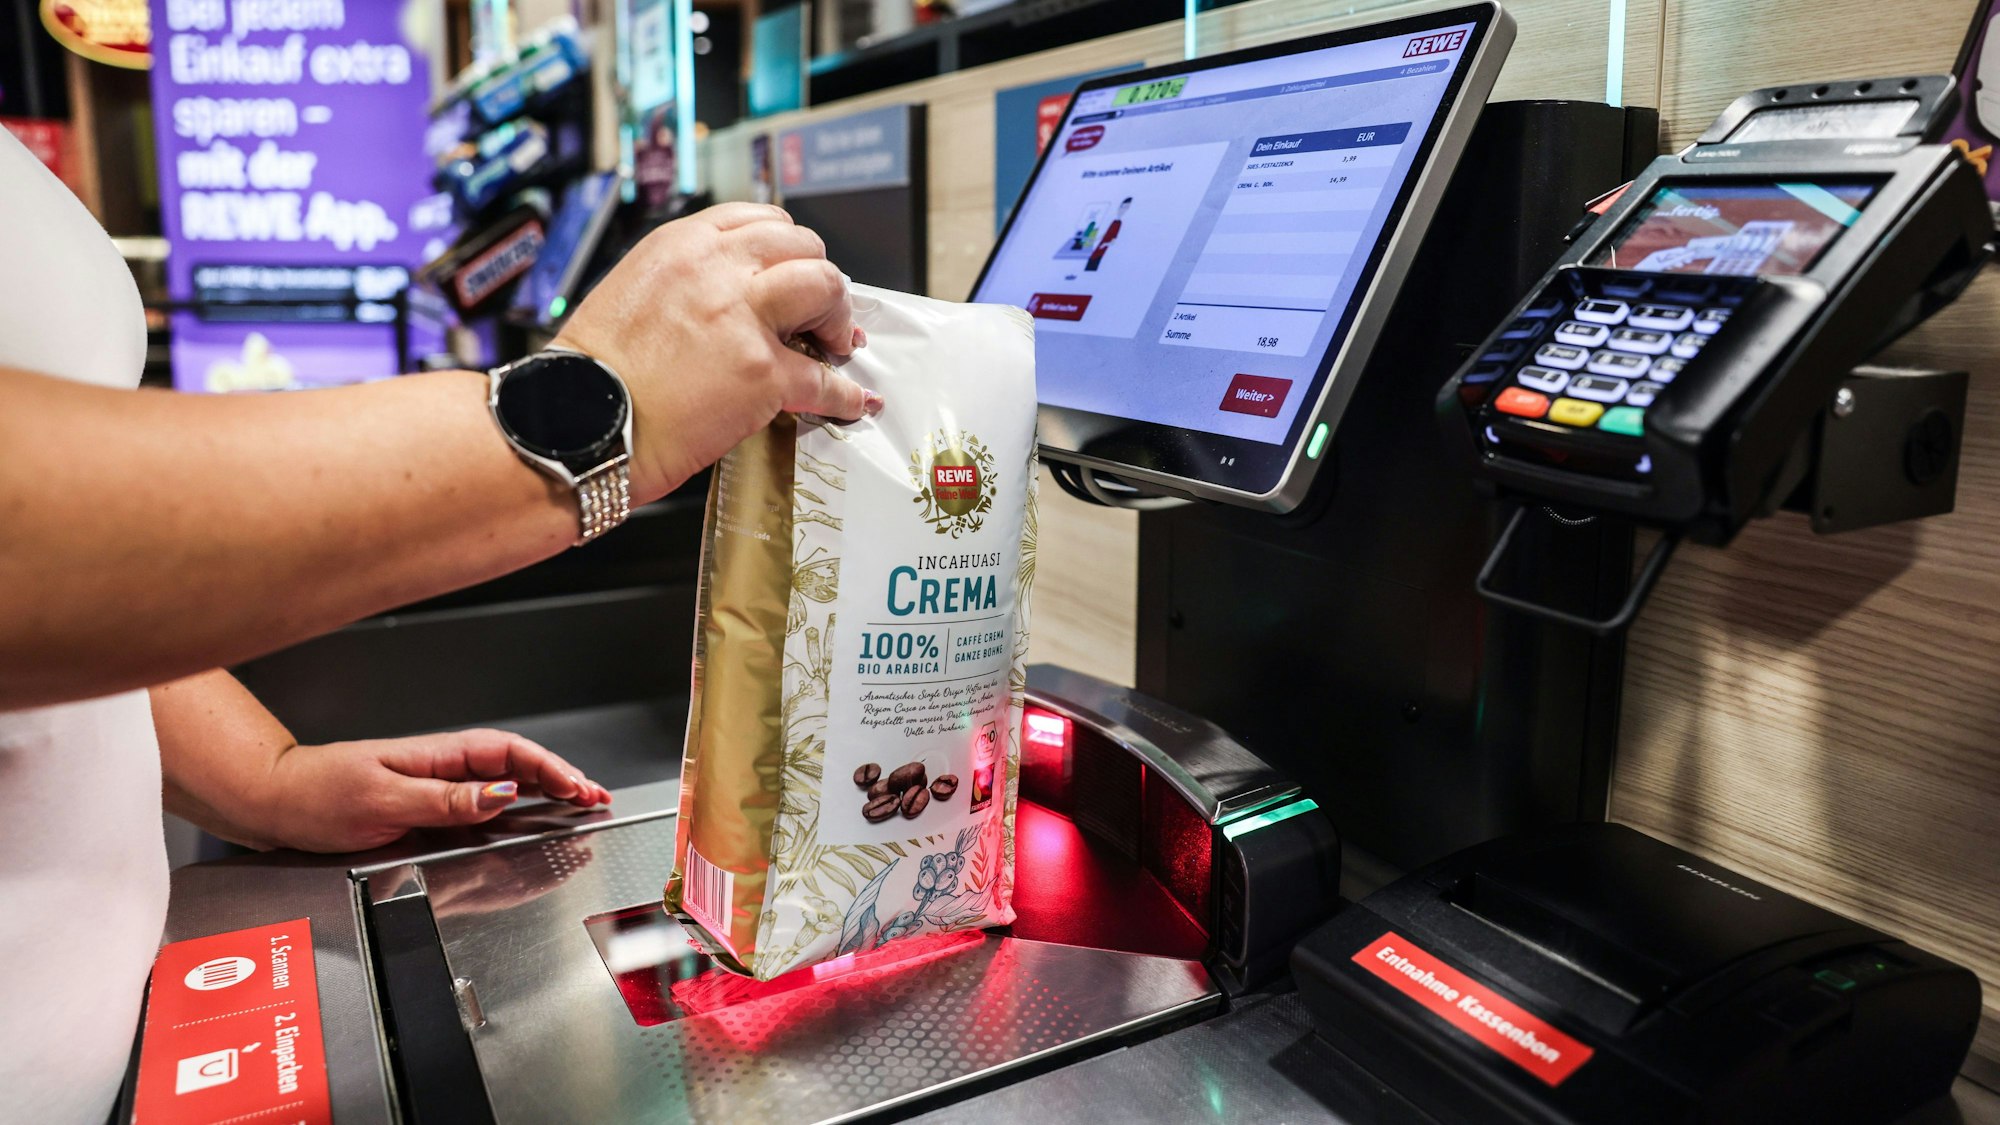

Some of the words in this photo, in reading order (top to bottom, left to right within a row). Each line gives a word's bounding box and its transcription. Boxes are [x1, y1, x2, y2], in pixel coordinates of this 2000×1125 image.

[1405, 31, 1464, 57] REWE
[169, 33, 306, 84] Einkauf
[309, 40, 412, 84] extra
[1406, 64, 1437, 75] Bezahlen
[173, 96, 298, 146] sparen
[1356, 131, 1376, 143] EUR
[1256, 141, 1272, 152] Dein
[1272, 138, 1302, 151] Einkauf
[177, 139, 247, 190] mit
[248, 140, 318, 190] der
[180, 191, 303, 241] REWE
[304, 191, 399, 252] App.
[1173, 312, 1179, 320] 2
[1178, 313, 1197, 321] Artikel
[1165, 329, 1192, 340] Summe
[1256, 337, 1279, 348] 18,98
[1235, 388, 1267, 402] Weiter
[936, 469, 974, 483] REWE
[917, 553, 1001, 570] INCAHUASI
[984, 630, 1004, 643] CREMA
[859, 632, 939, 659] 100%
[954, 650, 980, 663] GANZE
[983, 645, 1003, 658] BOHNE
[858, 663, 880, 674] BIO
[886, 662, 939, 674] ARABICA
[860, 691, 915, 701] Aromatischer
[918, 690, 941, 701] Single
[943, 688, 964, 699] Origin
[864, 704, 892, 716] Region
[894, 703, 917, 714] Cusco
[860, 716, 904, 728] hergestellt
[919, 715, 943, 723] unserer
[903, 726, 925, 737] Valle
[271, 934, 290, 945] 1.
[271, 946, 292, 990] Scannen
[1375, 945, 1460, 1002] Entnahme
[1456, 995, 1561, 1064] Kassenbon
[274, 1012, 297, 1026] 2.
[271, 1026, 304, 1094] Einpacken
